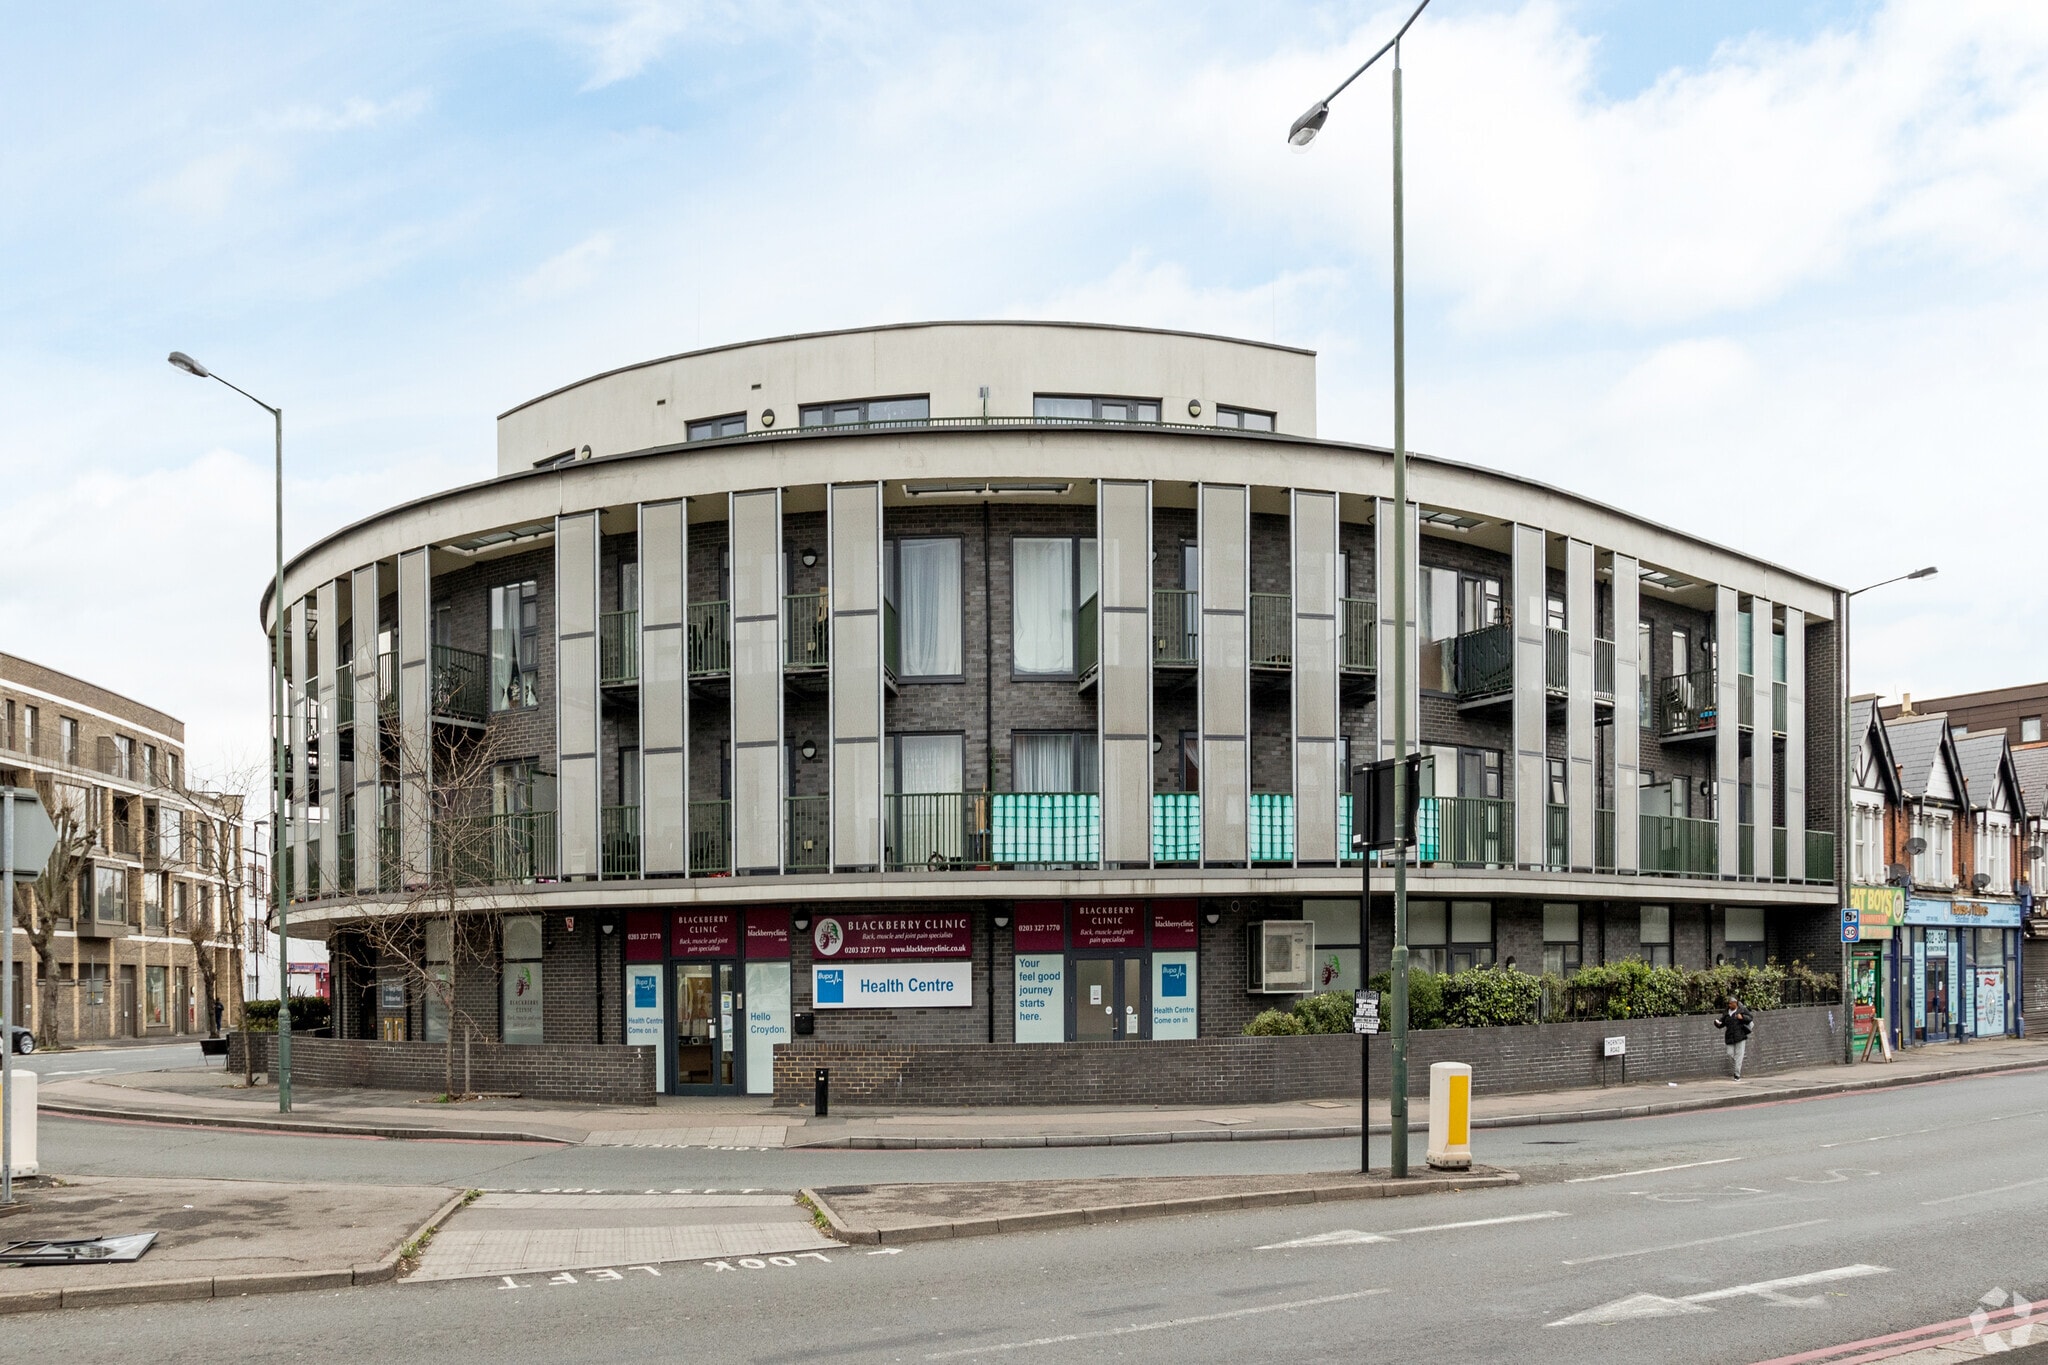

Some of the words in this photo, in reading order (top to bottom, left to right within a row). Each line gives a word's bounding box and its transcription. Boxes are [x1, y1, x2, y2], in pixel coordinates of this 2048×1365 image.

[1851, 888, 1867, 911] FAT
[1868, 888, 1893, 918] BOYS
[1080, 907, 1135, 915] BLACKBERRY
[678, 915, 728, 924] BLACKBERRY
[1092, 917, 1123, 925] CLINIC
[848, 920, 921, 931] BLACKBERRY
[925, 919, 967, 930] CLINIC
[1046, 924, 1061, 932] 1770
[1155, 920, 1194, 929] blackberryclinic
[689, 926, 718, 934] CLINIC
[747, 929, 787, 938] blackberryclinic
[1121, 928, 1134, 936] joint
[1845, 928, 1855, 936] 30
[904, 932, 916, 940] joint
[928, 932, 953, 940] specialists
[716, 937, 728, 945] joint
[699, 945, 721, 953] specialists
[872, 946, 886, 954] 1770
[891, 944, 967, 955] www.blackberryclinic.co.uk
[1019, 959, 1040, 968] Your
[1019, 972, 1036, 981] feel
[1038, 972, 1061, 984] good
[861, 978, 904, 993] Health
[909, 977, 954, 992] Centre
[1019, 986, 1054, 997] journey
[1020, 1000, 1045, 1008] starts
[1154, 1006, 1174, 1014] Health
[1175, 1006, 1195, 1014] Centre
[750, 1013, 771, 1021] Hello
[1020, 1012, 1042, 1021] here.
[1154, 1016, 1171, 1024] Come
[750, 1025, 788, 1036] Croydon.
[705, 1252, 833, 1273] LOOK
[498, 1265, 664, 1291] LEFT
